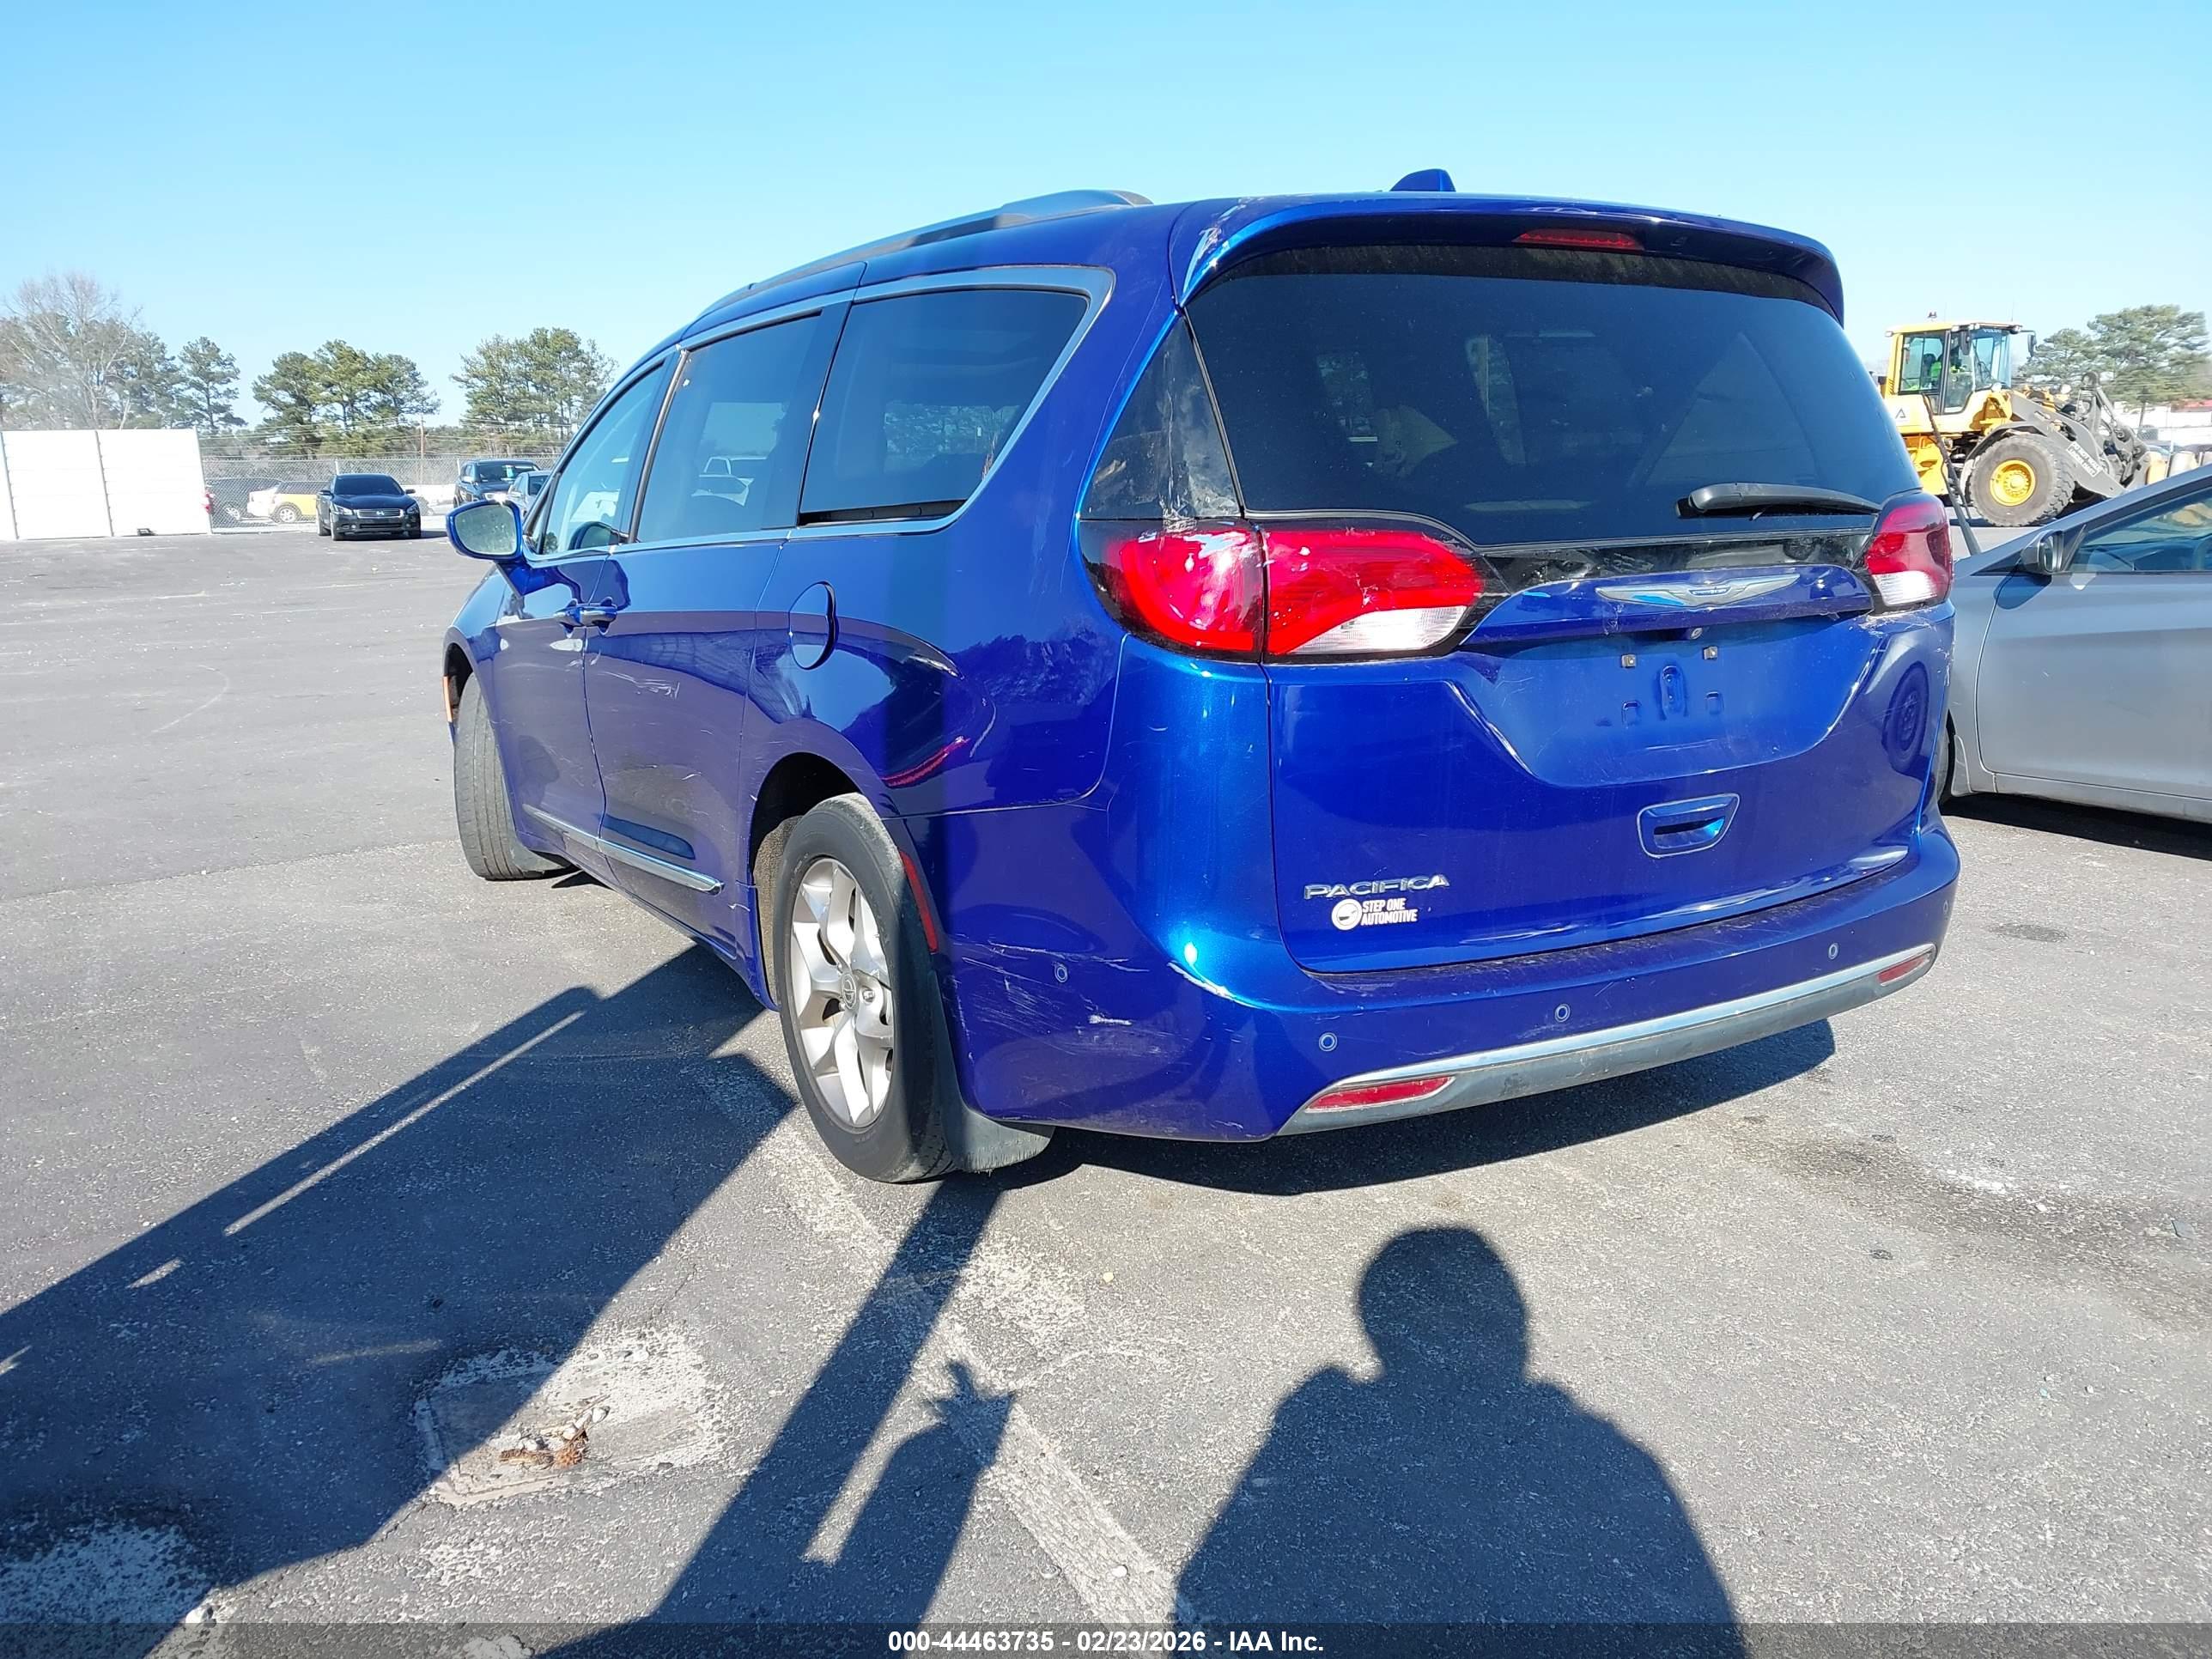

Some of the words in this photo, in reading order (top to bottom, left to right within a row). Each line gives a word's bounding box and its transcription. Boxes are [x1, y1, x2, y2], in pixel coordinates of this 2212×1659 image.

[1304, 874, 1450, 899] PACIFICA
[1362, 900, 1385, 913] STEP
[1387, 898, 1407, 910] ONE
[1360, 909, 1418, 926] AUTOMOTIVE
